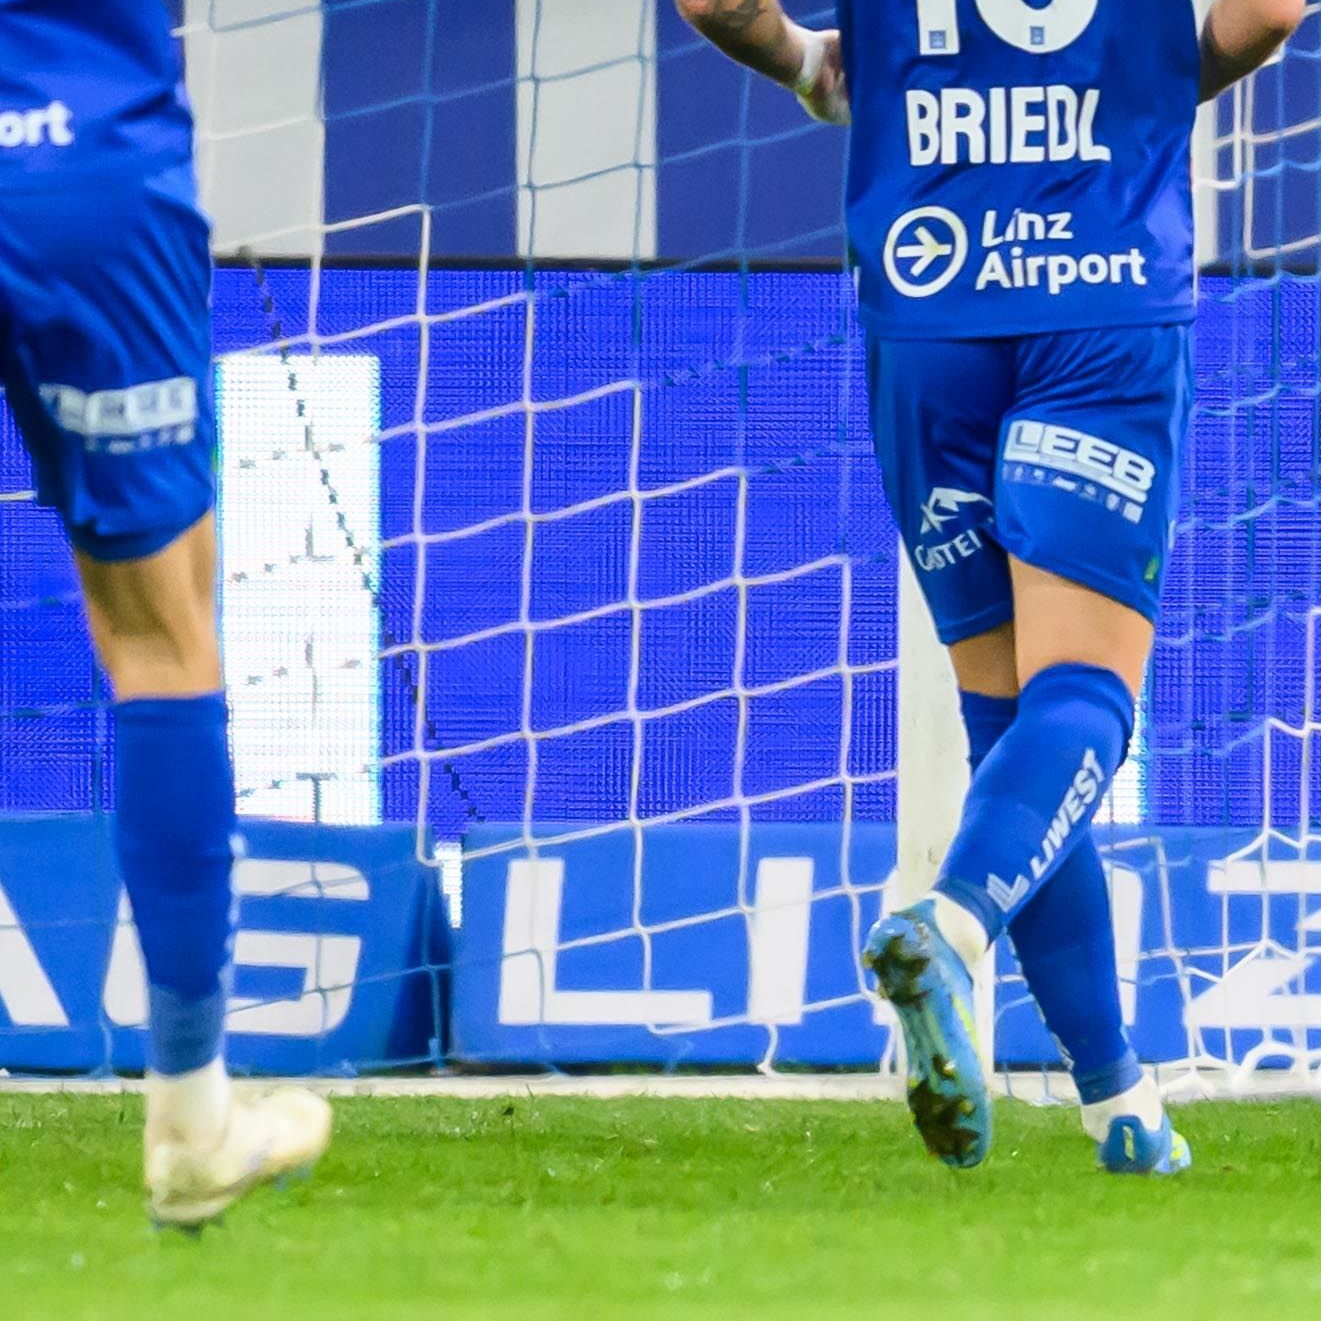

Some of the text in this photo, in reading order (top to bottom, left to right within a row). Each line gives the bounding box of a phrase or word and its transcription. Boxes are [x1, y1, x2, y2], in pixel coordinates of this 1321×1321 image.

[906, 84, 1111, 166] BRIEDL
[982, 208, 1073, 243] Linz
[975, 248, 1147, 293] Airport
[1004, 420, 1156, 502] LEEB
[1030, 748, 1106, 882] LIWEST
